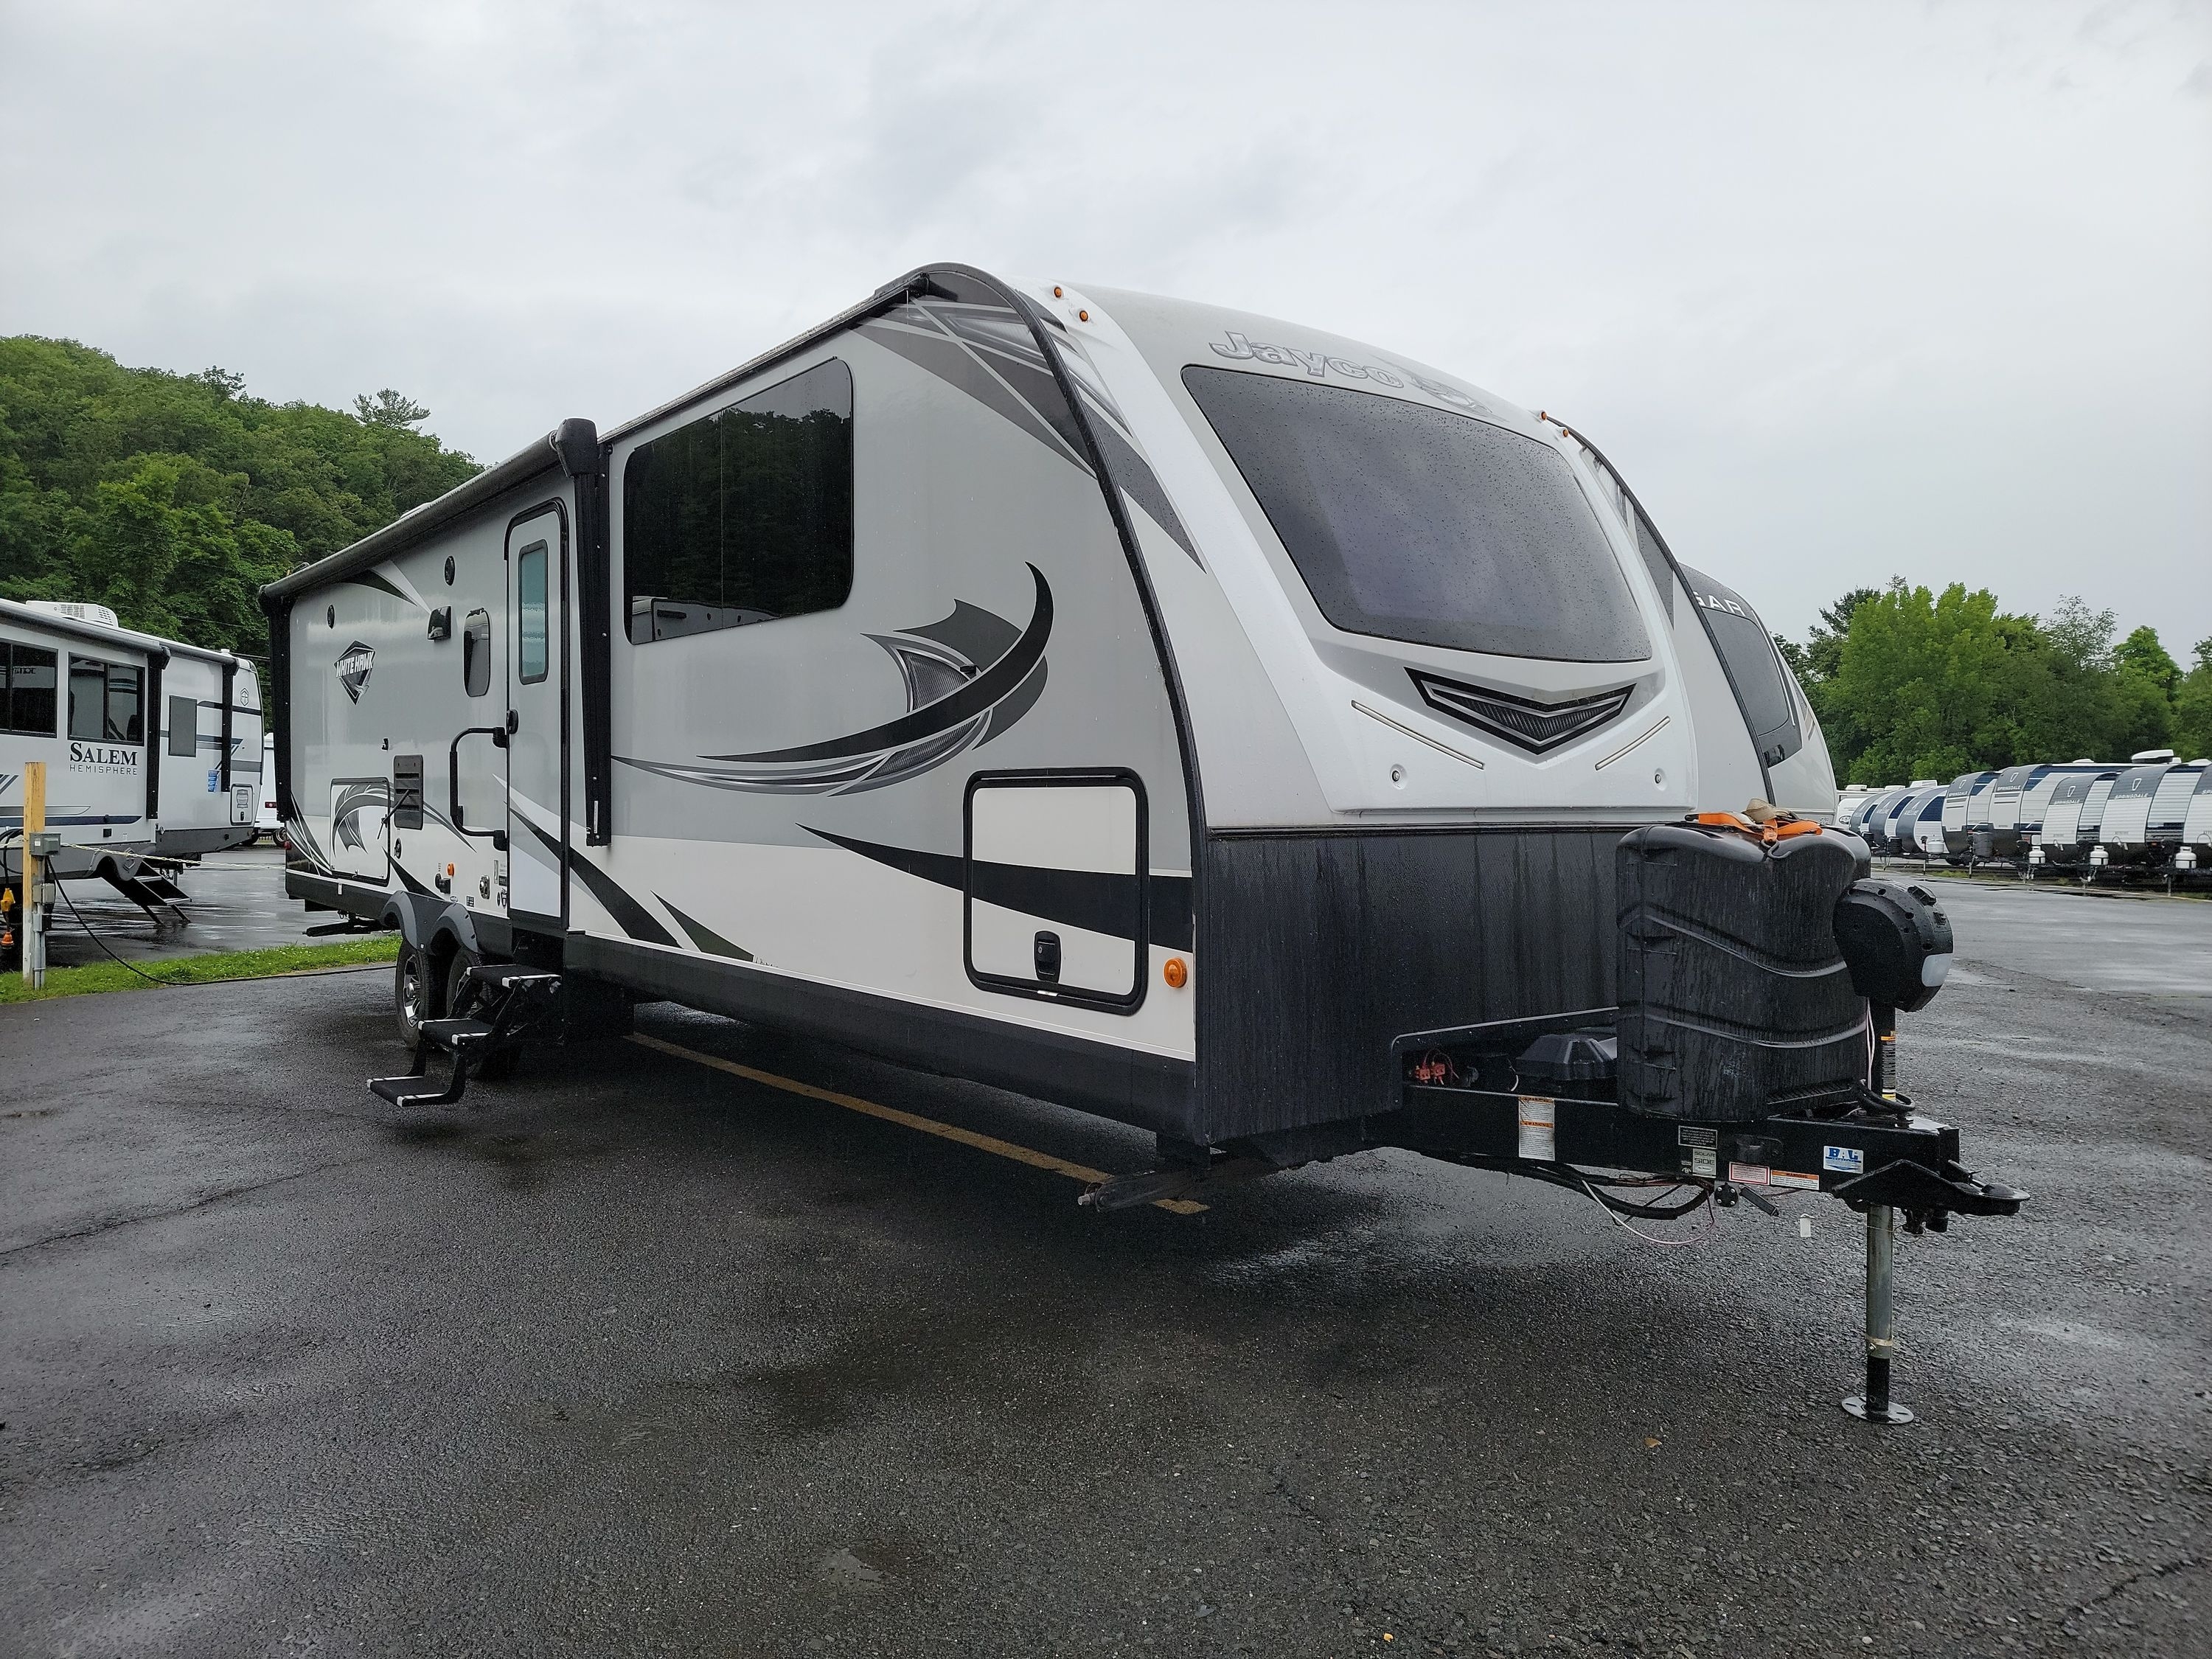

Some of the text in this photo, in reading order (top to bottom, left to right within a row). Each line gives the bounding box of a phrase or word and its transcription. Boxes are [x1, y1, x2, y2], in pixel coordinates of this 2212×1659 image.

[1208, 330, 1404, 388] Jayco
[70, 742, 137, 766] SALEM
[69, 764, 137, 775] HEMISPHERE
